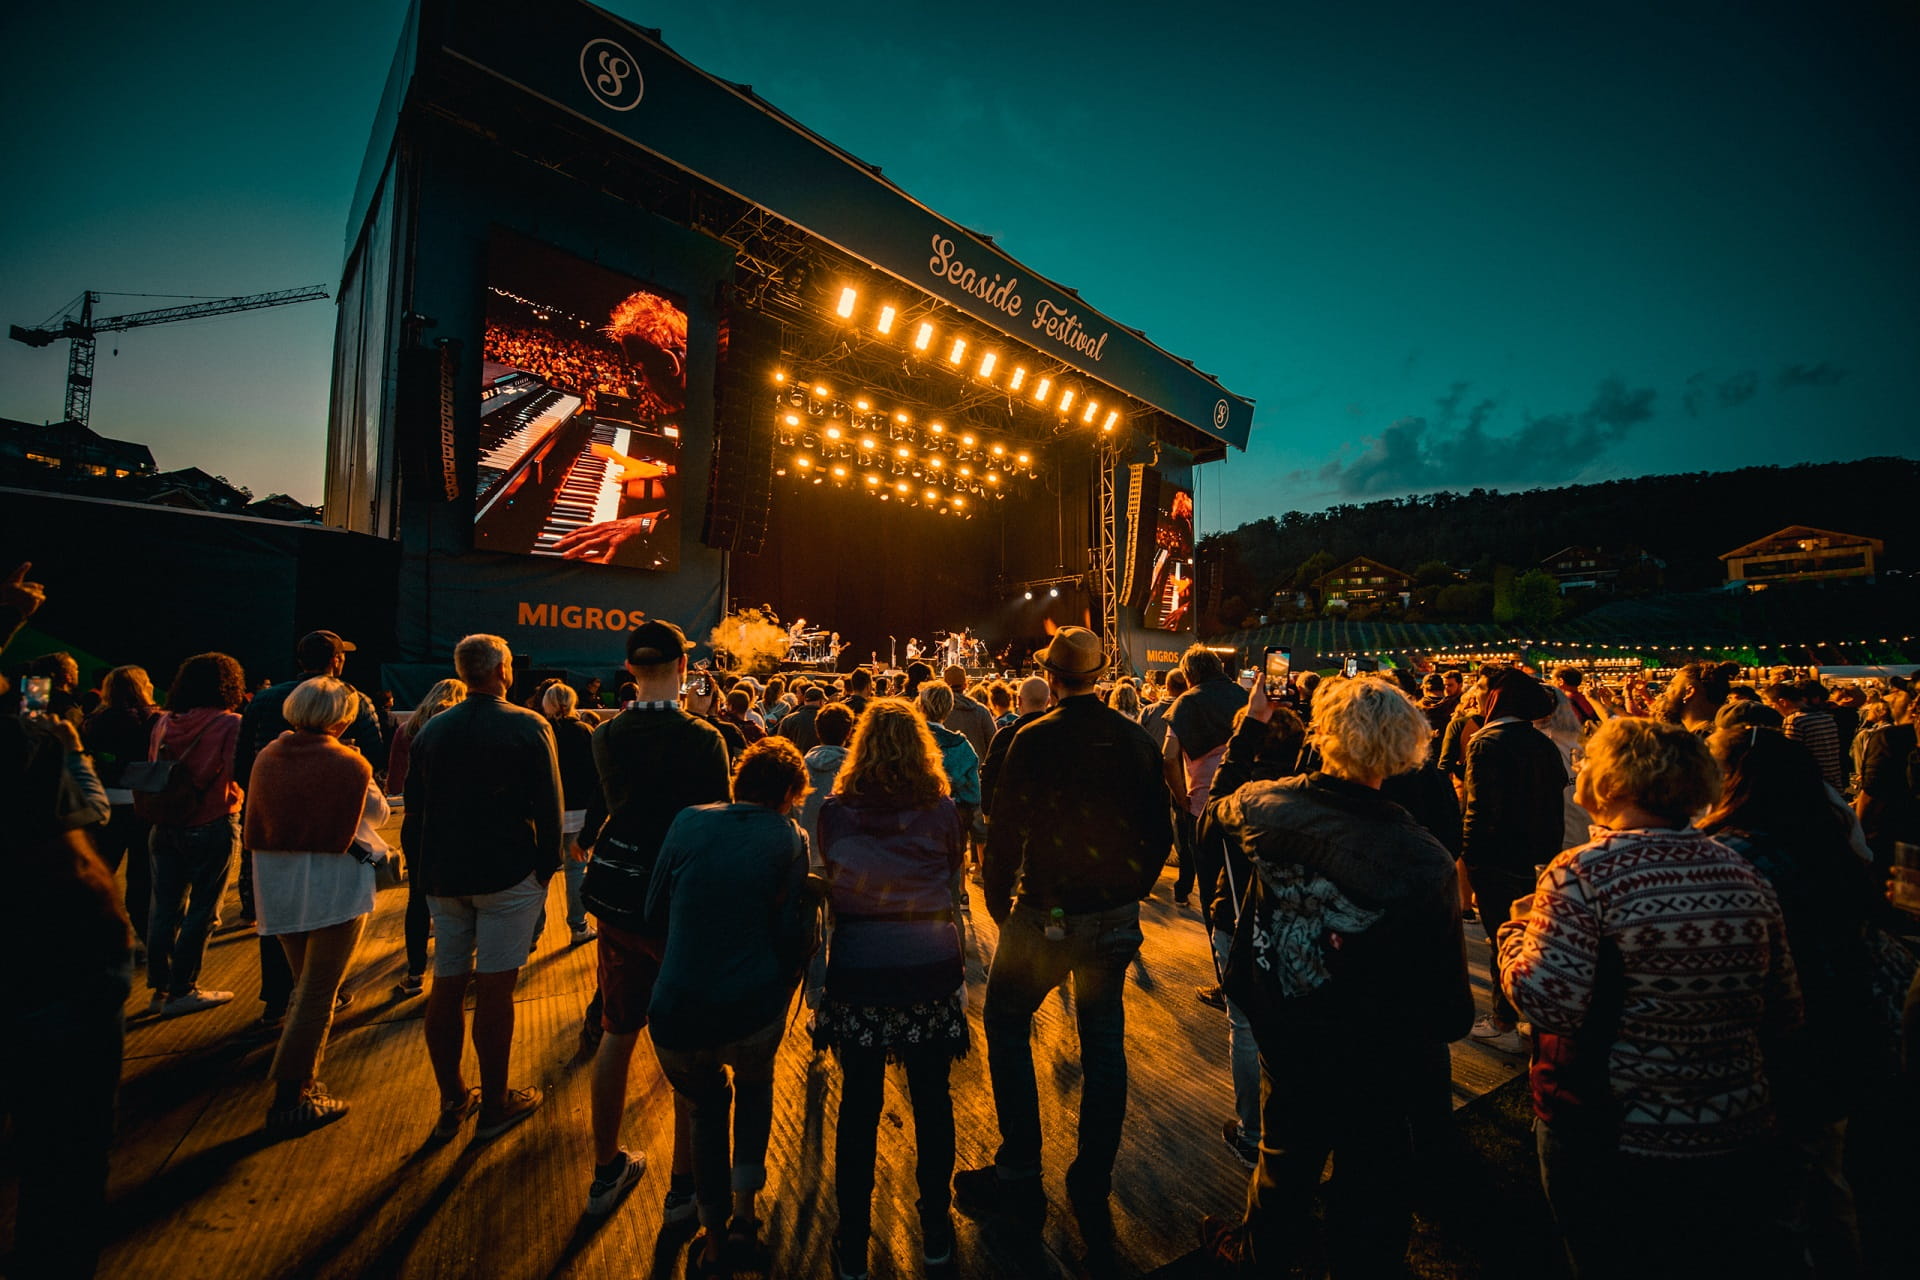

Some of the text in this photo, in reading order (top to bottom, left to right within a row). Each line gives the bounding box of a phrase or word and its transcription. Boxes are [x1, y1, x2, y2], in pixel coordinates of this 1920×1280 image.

[929, 233, 1109, 361] Seaside Festival
[518, 602, 646, 632] MIGROS
[1146, 649, 1179, 663] MIGROS
